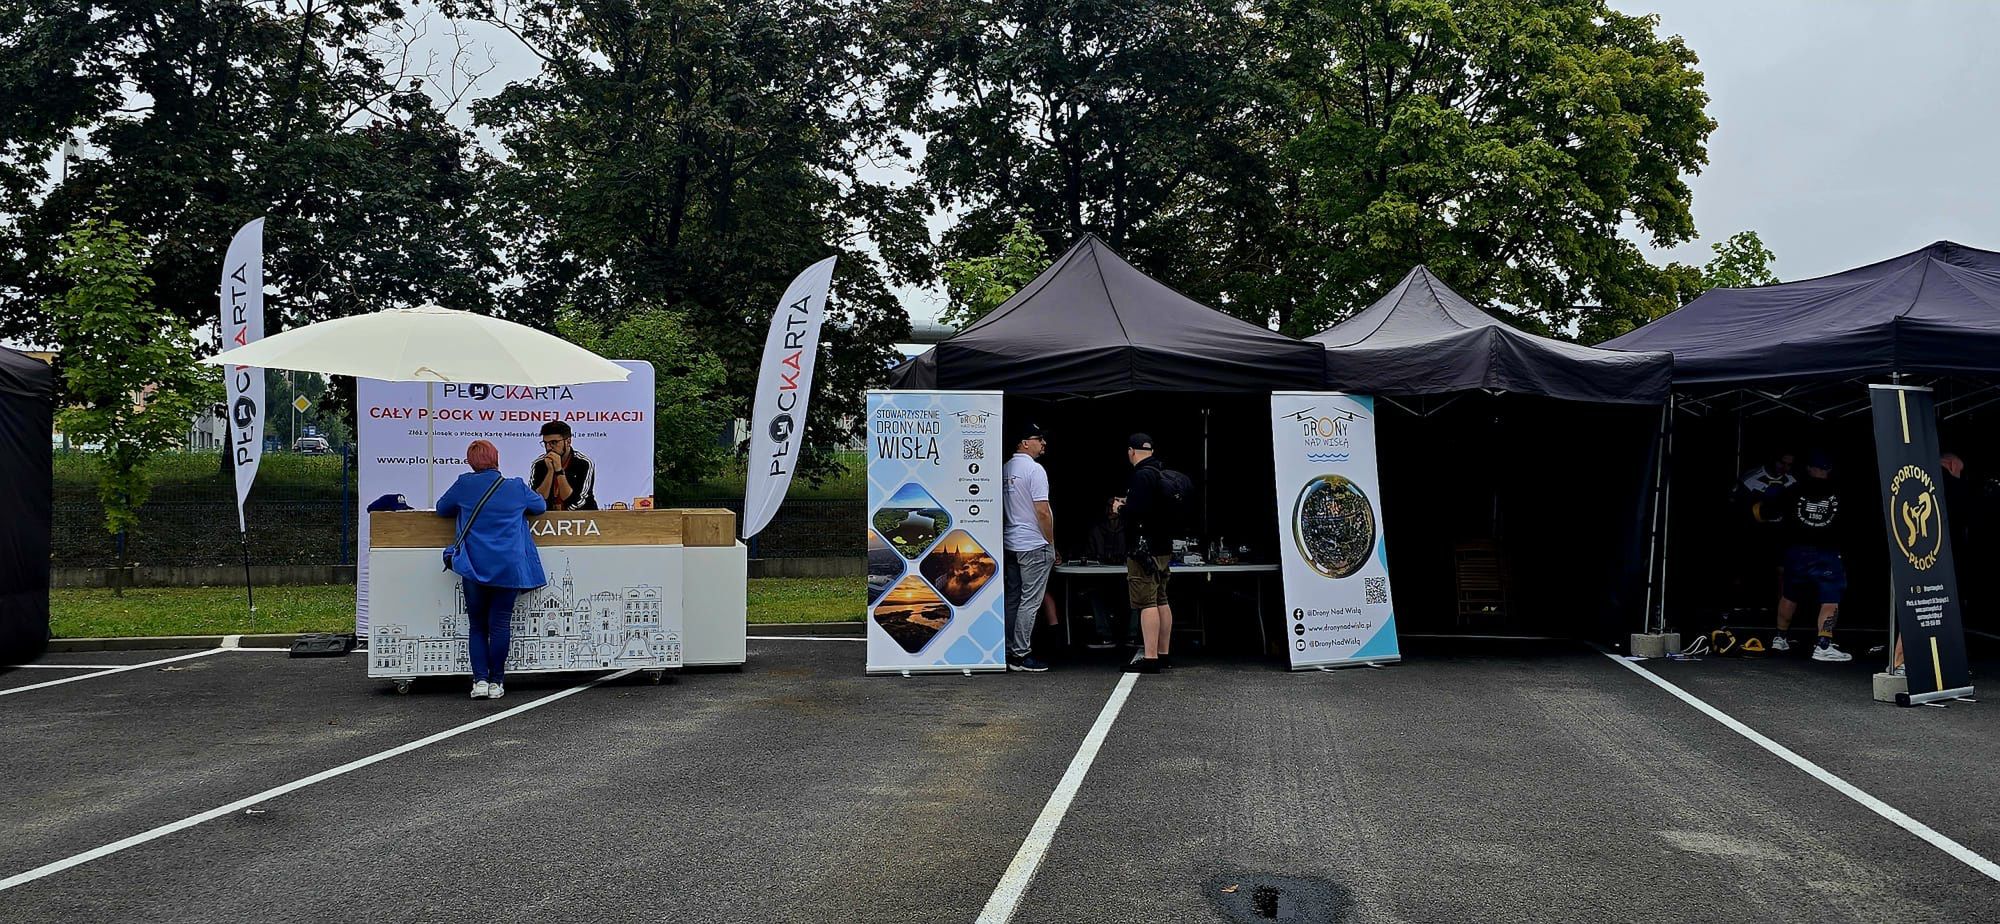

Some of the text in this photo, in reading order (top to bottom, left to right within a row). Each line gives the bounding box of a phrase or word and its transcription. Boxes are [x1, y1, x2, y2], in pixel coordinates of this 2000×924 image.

[444, 383, 573, 400] PŁOCKARTA
[769, 294, 812, 476] PŁOCKARTA
[370, 407, 413, 419] CAŁY
[478, 410, 495, 421] W
[499, 410, 559, 422] JEDNEJ
[564, 411, 643, 422] APLIKACJI
[876, 410, 940, 419] STOWARZYSZENIE
[960, 415, 986, 424] DRONY
[876, 421, 940, 435] DRONY NAD
[1304, 417, 1347, 437] DRONY
[1304, 438, 1321, 447] NAD
[877, 436, 940, 465] WISŁĄ
[1890, 464, 1936, 496] SPORTOWY
[1908, 550, 1937, 571] PŁOCK
[1307, 609, 1330, 618] @Drony
[1330, 607, 1344, 615] Nad
[1308, 621, 1372, 632] www.dronynadwisla.pl
